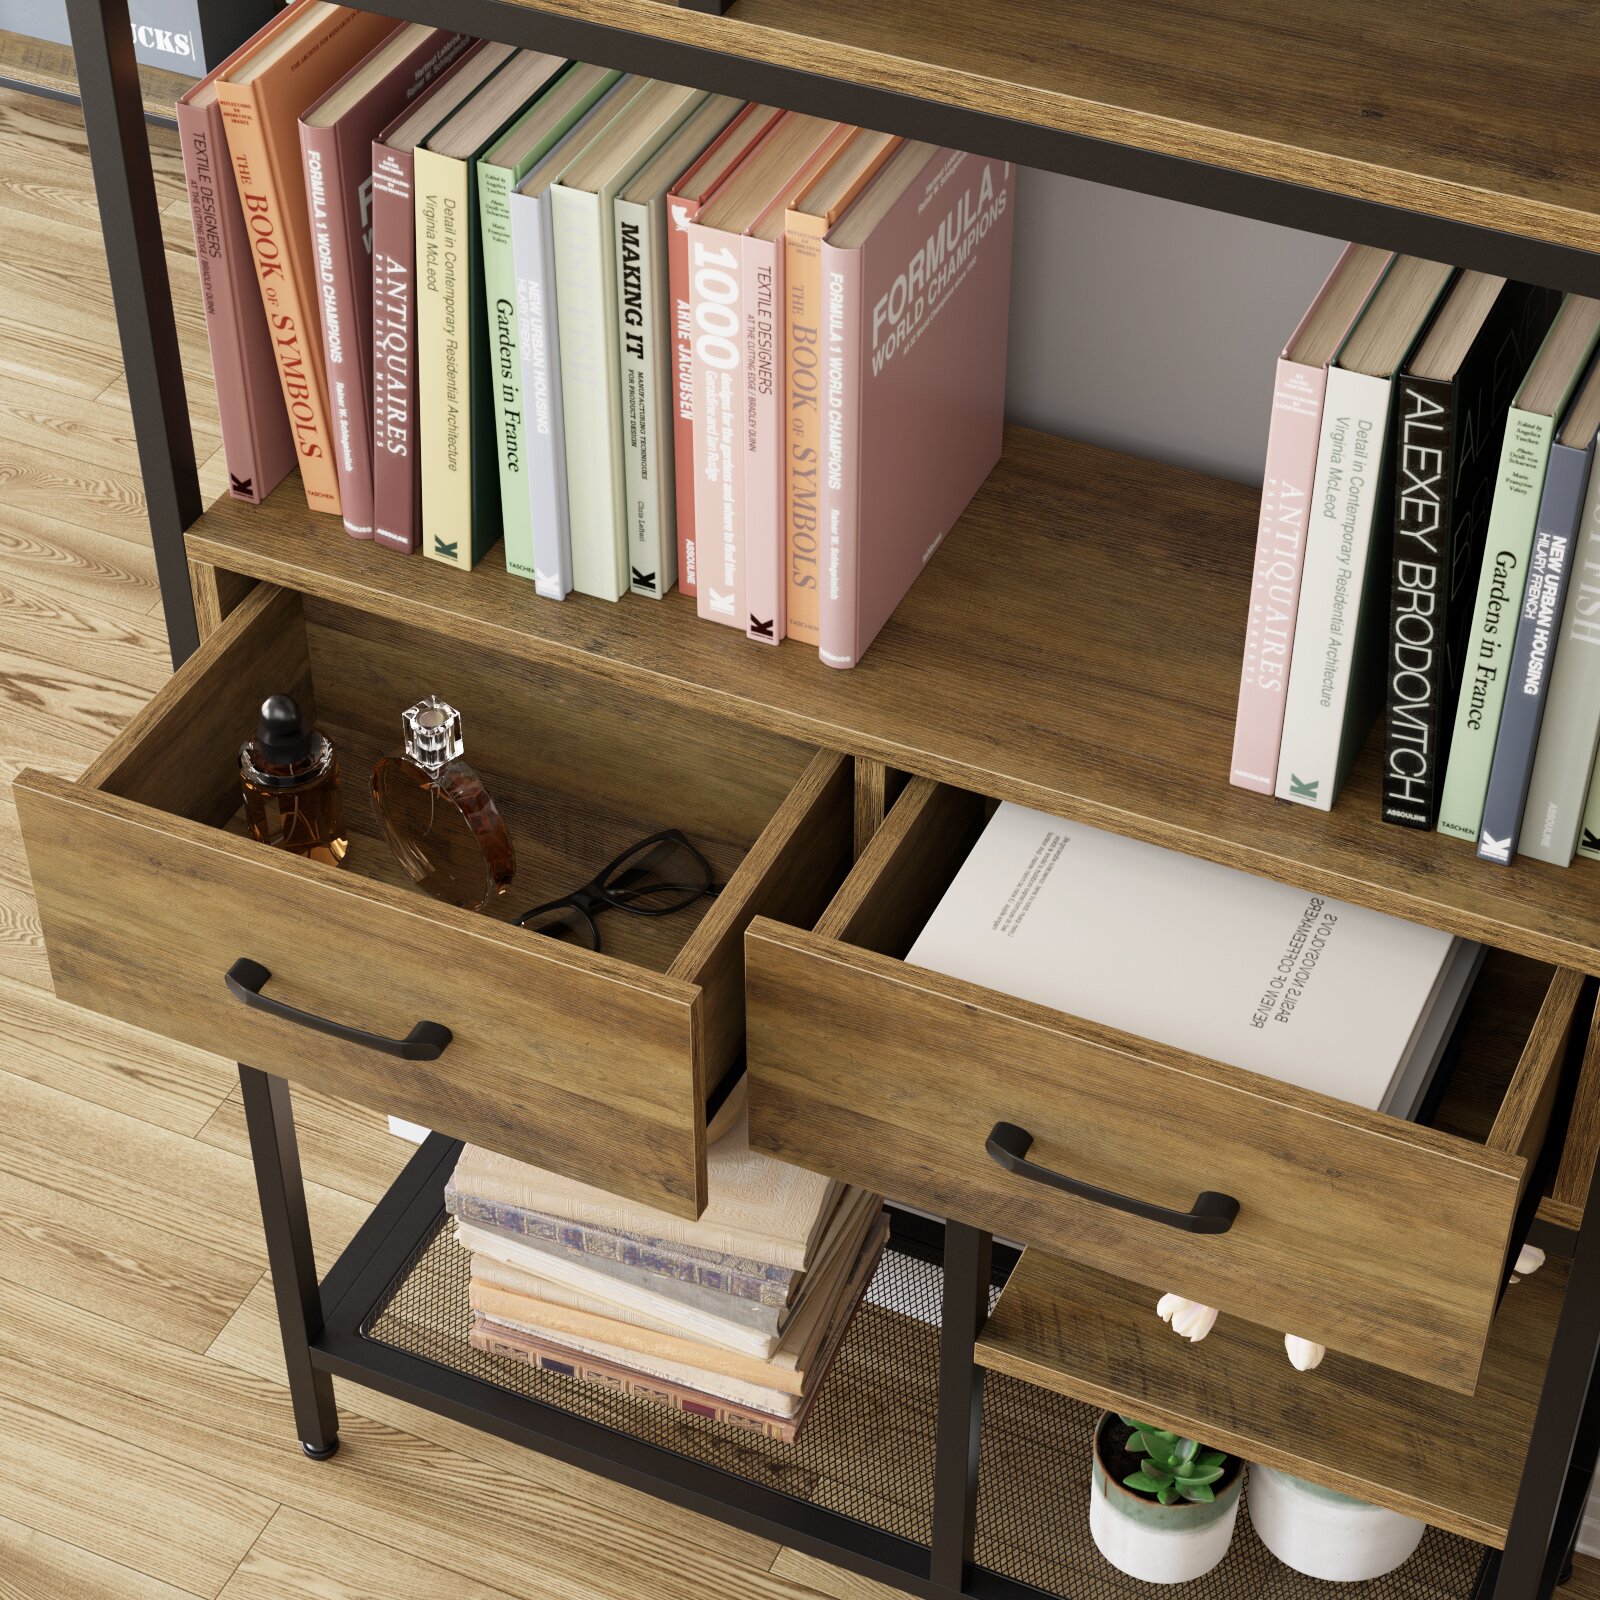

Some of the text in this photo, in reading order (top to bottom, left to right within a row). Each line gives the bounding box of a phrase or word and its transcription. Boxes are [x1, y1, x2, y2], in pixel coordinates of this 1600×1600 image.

[193, 132, 221, 259] TEXTILE DESIGNERS
[307, 149, 327, 219] FORMULA
[315, 221, 328, 229] 1
[201, 259, 212, 293] BRADLEY
[317, 232, 334, 284] WORLD
[422, 194, 439, 293] Virginia McLeod
[872, 296, 924, 377] WORLD
[928, 188, 1007, 306] CHAMPIONS
[873, 163, 993, 350] FORMULA
[206, 292, 216, 315] QUINN
[236, 154, 323, 459] THE BOOK OF SYMBOLS
[323, 284, 343, 364] CHAMPIONS
[443, 198, 459, 472] Detail in Contemporary Residential Architecture
[621, 221, 644, 360] MAKING IT
[694, 241, 740, 370] 1000
[747, 325, 755, 339] THE
[757, 266, 773, 395] TEXTILE DESIGNERS
[829, 271, 844, 342] FORMULA
[383, 256, 408, 457] ANTIQUAIRES
[496, 298, 521, 473] Gardens in France
[528, 280, 549, 434] NEW URBAN HOUSING
[747, 340, 756, 373] CUTTING
[748, 373, 756, 392] EDGE
[829, 355, 843, 409] WORLD
[830, 344, 843, 353] 1
[376, 372, 384, 448] MARKETS
[637, 371, 648, 481] MANUFACTURING TECHNIQUES
[748, 396, 757, 429] BRADLEY
[748, 429, 757, 452] QUINN
[792, 285, 818, 590] THE BOOK OF SYMBOLS
[828, 410, 842, 490] CHAMPIONS
[1323, 416, 1351, 521] Virginia McLeod
[1258, 480, 1305, 693] ANTIQUAIRES
[1320, 419, 1373, 708] Detail in Contemporary Residential Architecture
[1388, 388, 1445, 803] ALEXEY BRODOVITCH
[1524, 532, 1551, 620] HILARY FRENCH
[1245, 603, 1263, 684] MARKETS
[1467, 550, 1517, 730] Gardens in France
[1524, 535, 1568, 695] NEW URBAN HOUSING
[1386, 808, 1427, 823] ASSOULINE
[1441, 820, 1475, 835] TASCHEN
